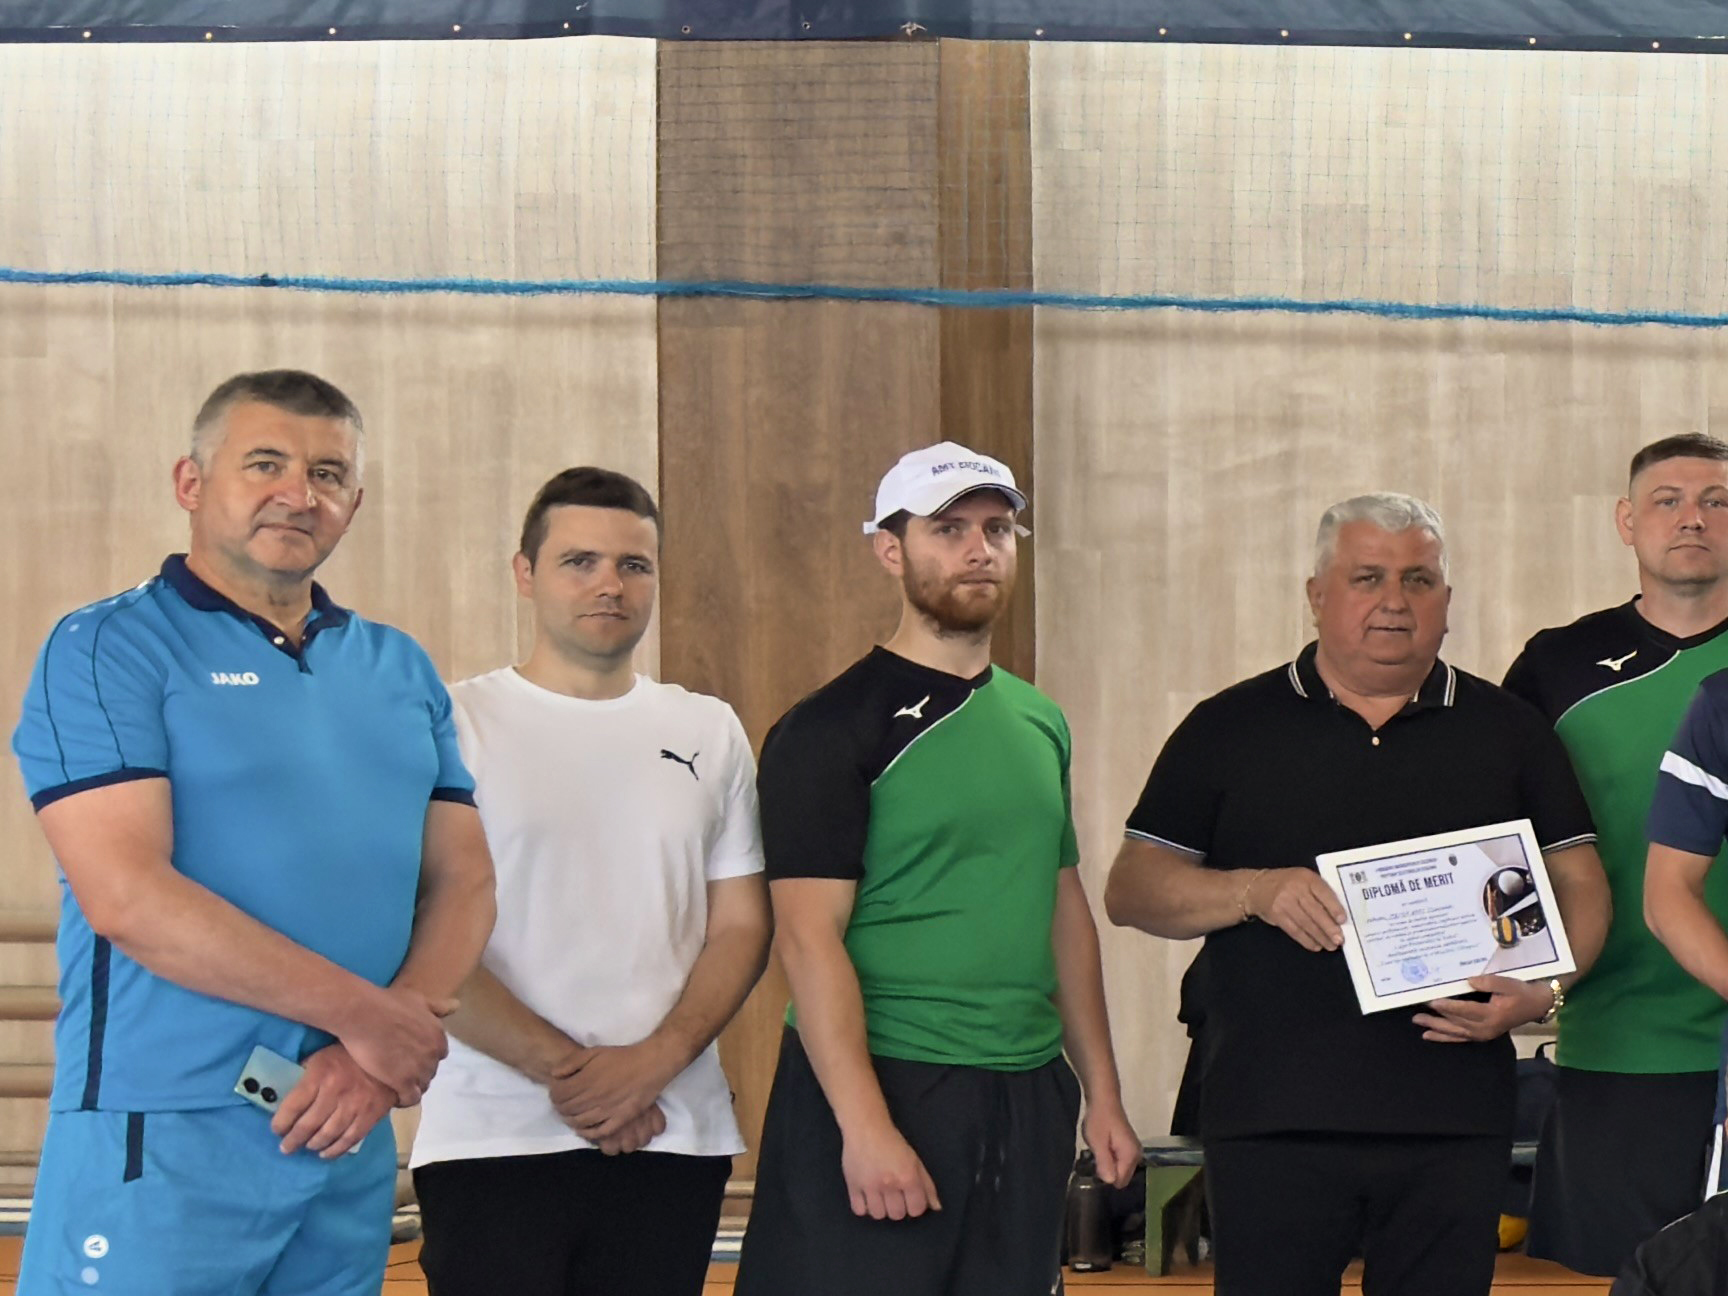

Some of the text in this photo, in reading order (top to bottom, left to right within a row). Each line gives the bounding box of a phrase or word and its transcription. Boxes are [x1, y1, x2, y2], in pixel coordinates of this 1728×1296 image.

[211, 672, 259, 685] JAKO
[1362, 872, 1455, 901] DIPLOMĂ DE MERIT
